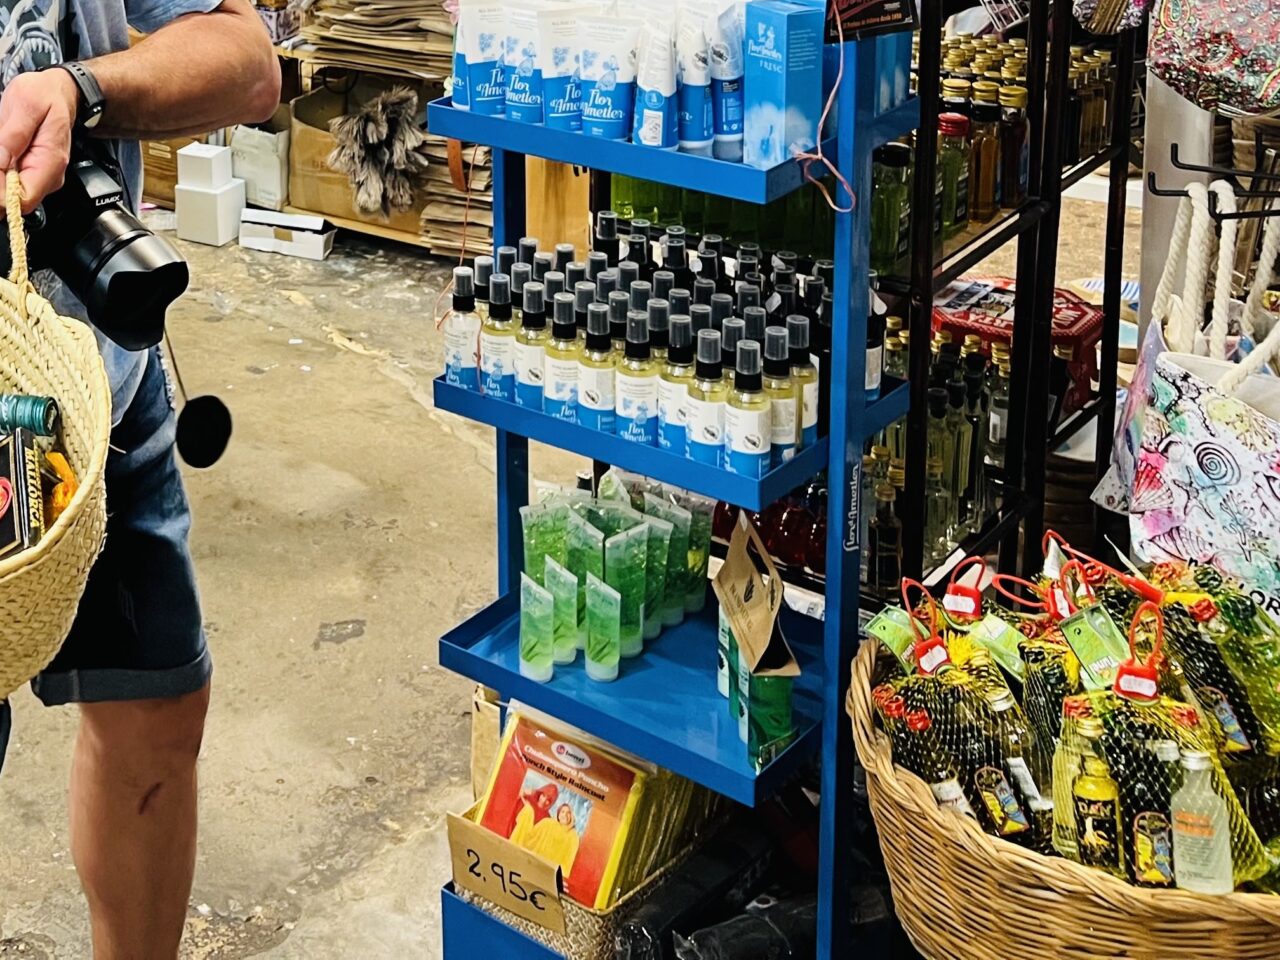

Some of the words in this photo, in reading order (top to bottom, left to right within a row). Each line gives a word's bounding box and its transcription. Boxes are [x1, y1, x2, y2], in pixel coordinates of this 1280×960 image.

[95, 194, 121, 206] LUMIX
[24, 446, 41, 529] MALLORCA
[546, 765, 568, 782] Style
[567, 777, 606, 802] Raincoat
[577, 769, 611, 793] Poncho
